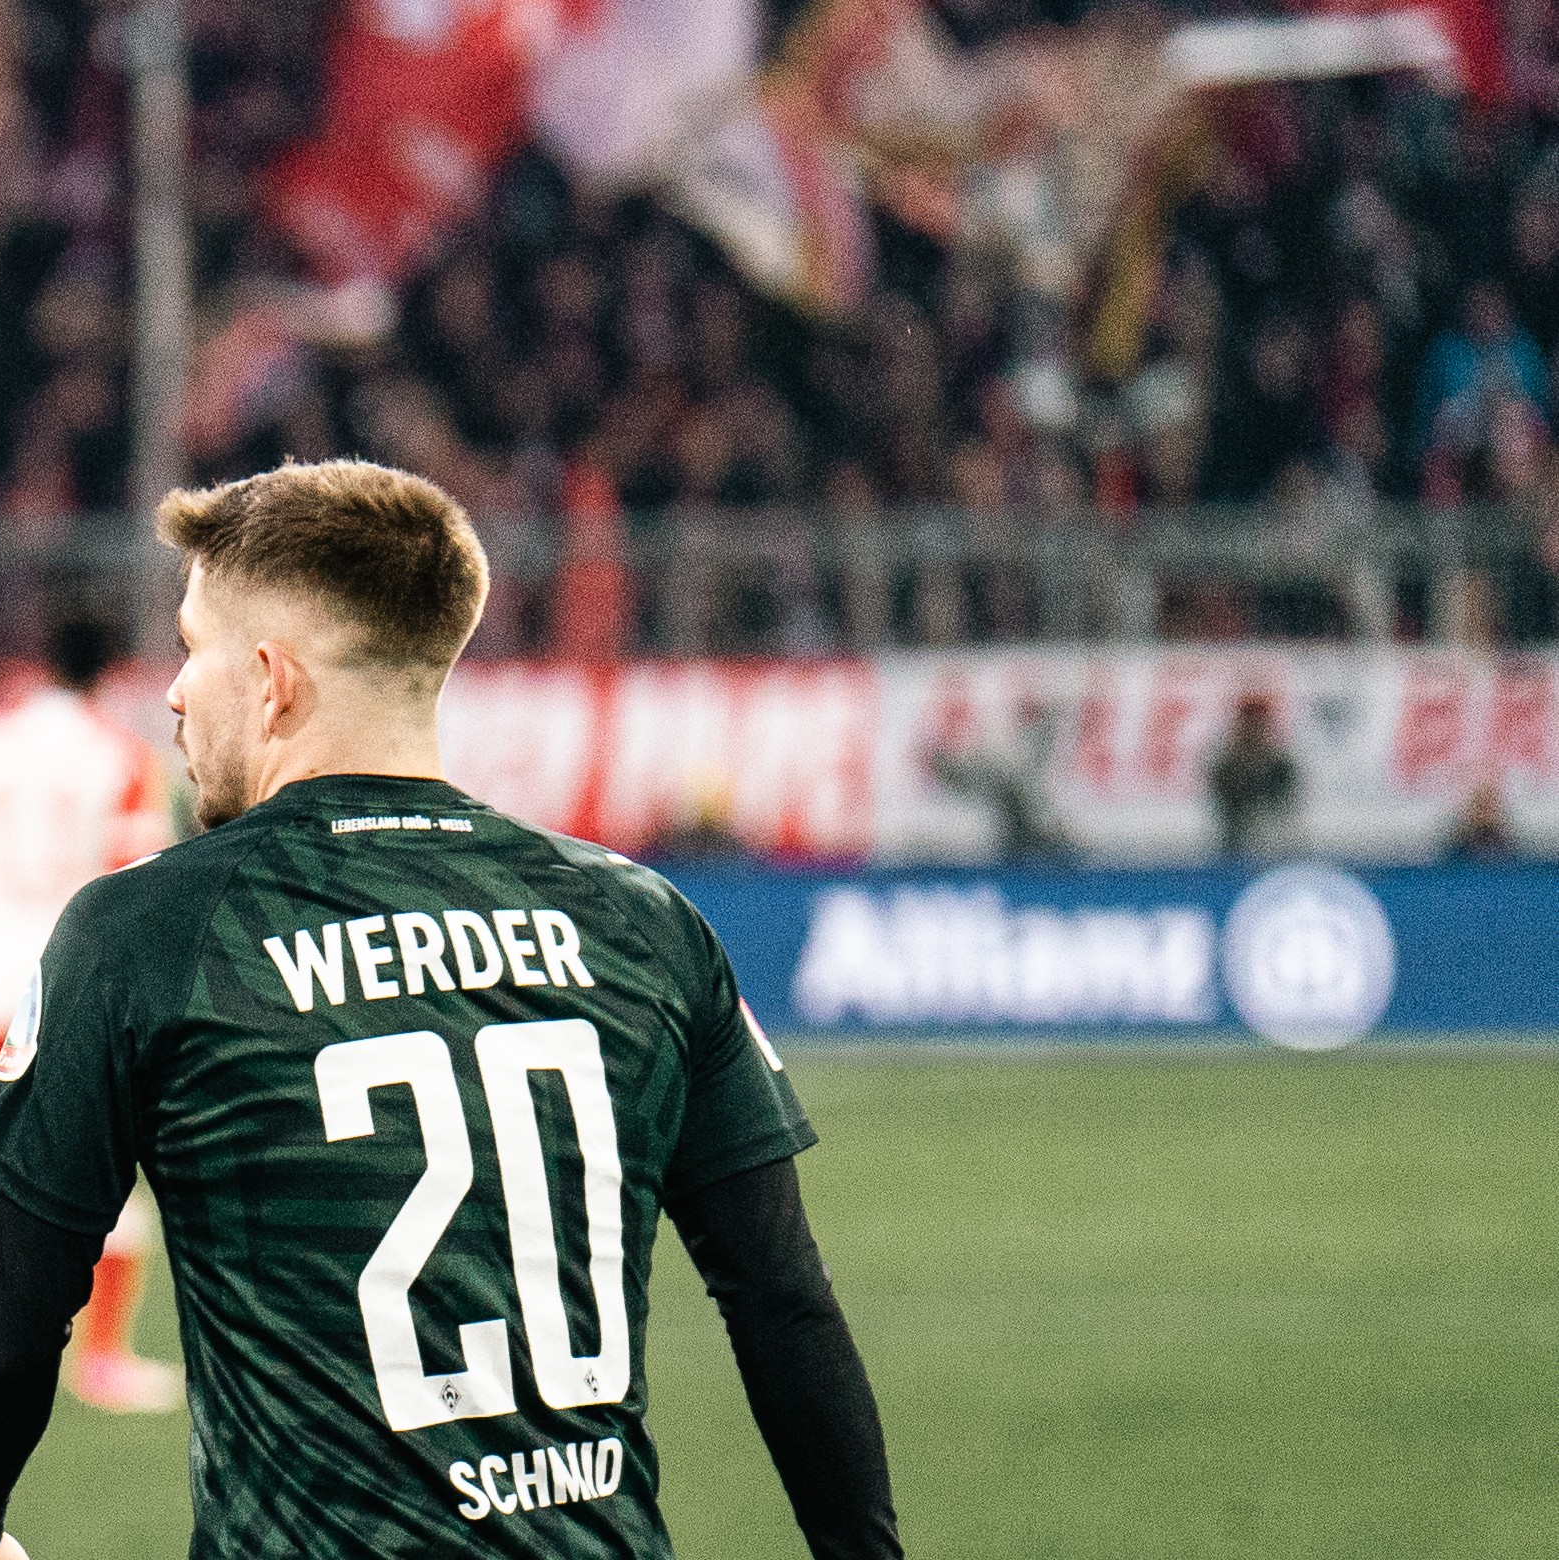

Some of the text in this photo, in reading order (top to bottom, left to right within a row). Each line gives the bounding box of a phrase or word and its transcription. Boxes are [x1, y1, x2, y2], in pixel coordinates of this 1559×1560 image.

[331, 816, 401, 834] LEBENSLANG
[402, 815, 431, 830] GRÜN
[438, 818, 473, 832] WEISS
[264, 911, 595, 1012] WERDER
[316, 1020, 631, 1431] 20
[450, 1439, 623, 1520] SCHMID
